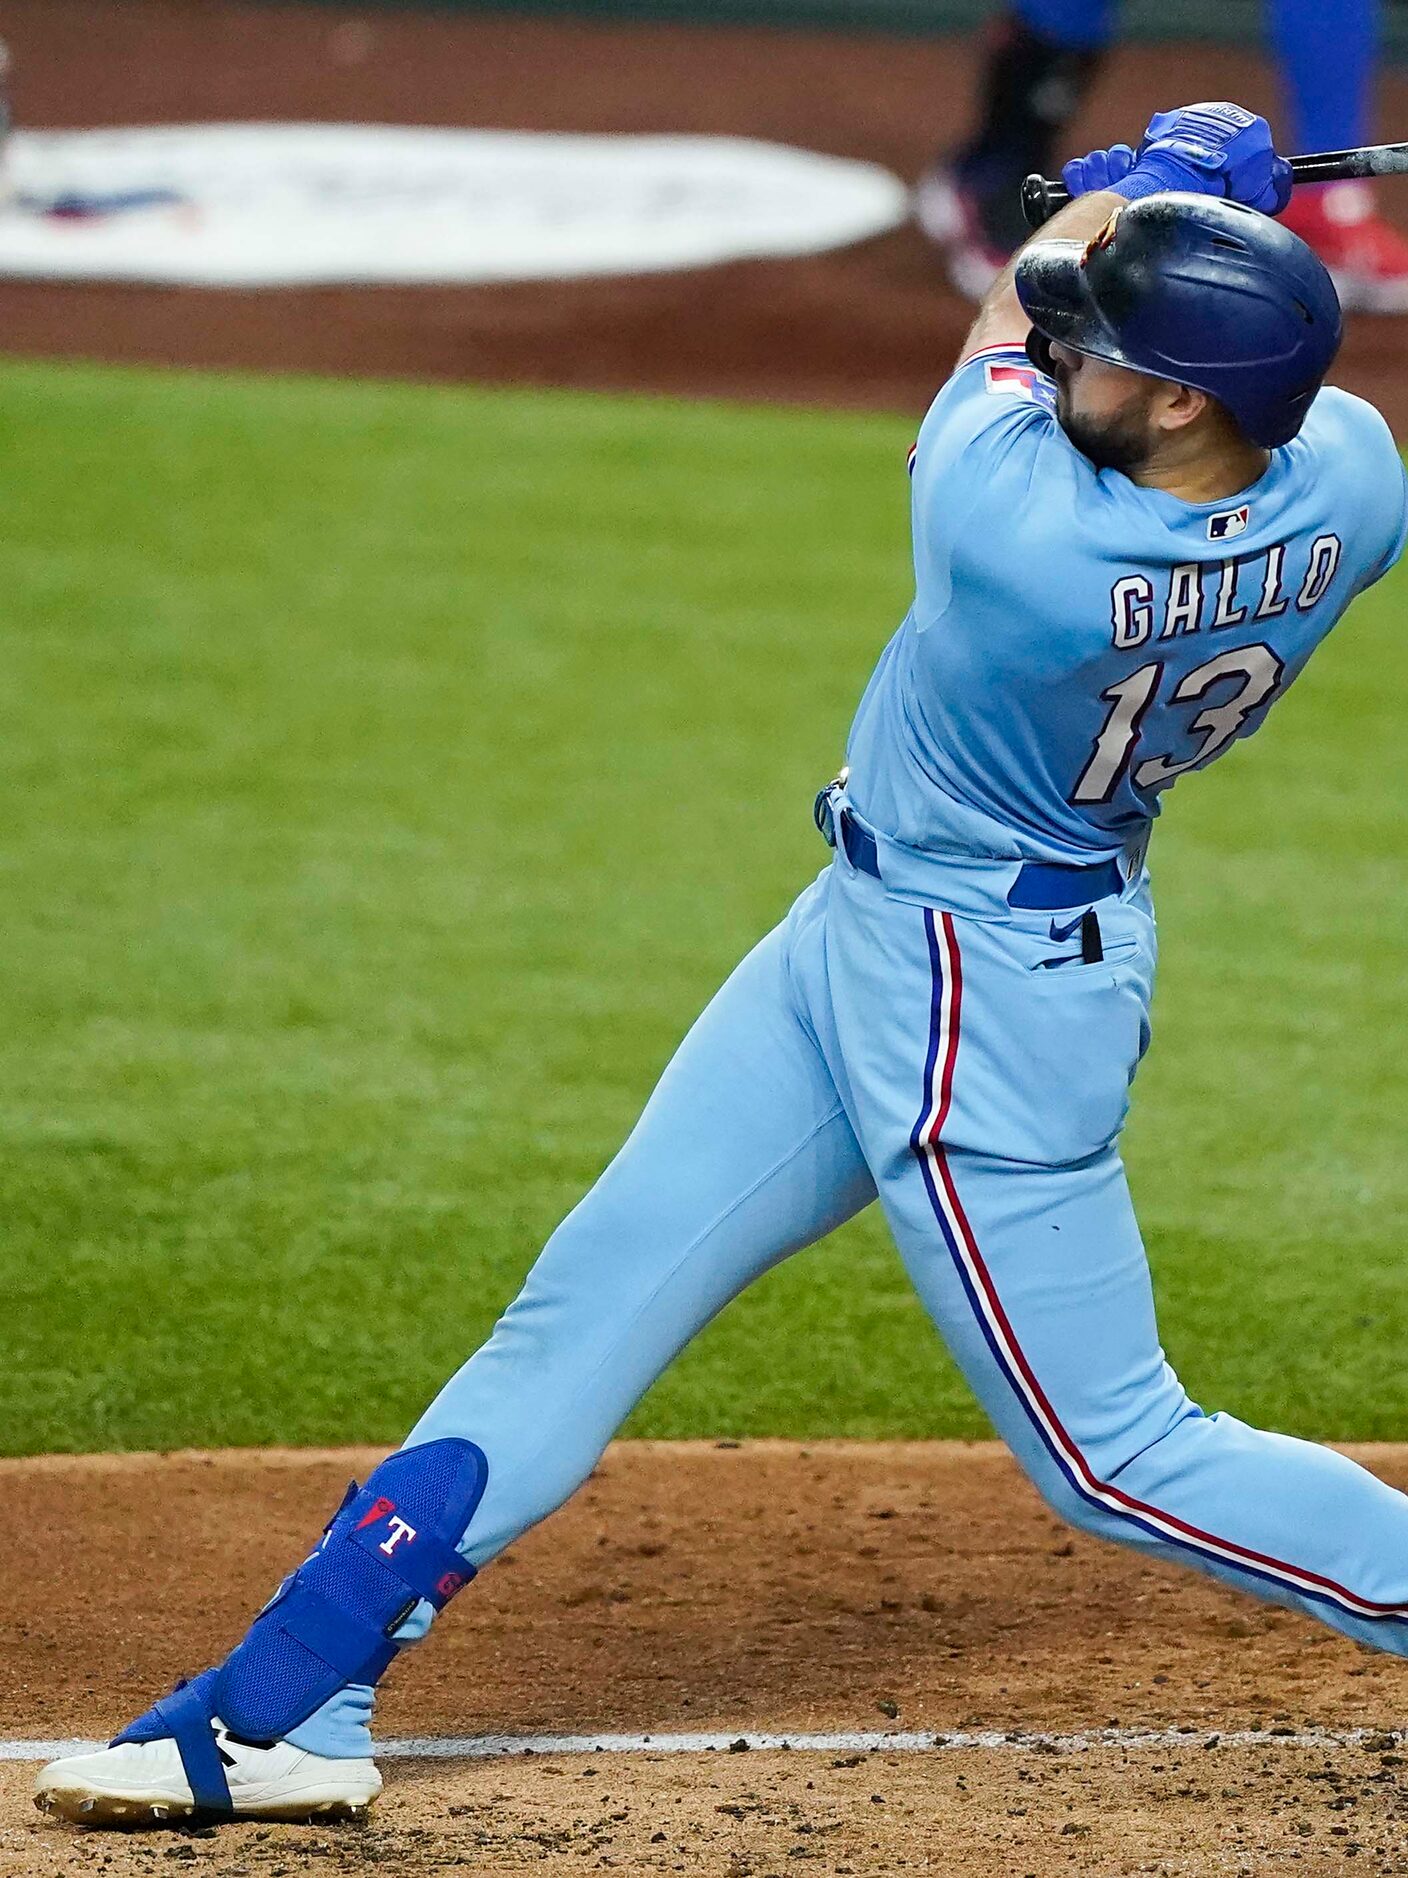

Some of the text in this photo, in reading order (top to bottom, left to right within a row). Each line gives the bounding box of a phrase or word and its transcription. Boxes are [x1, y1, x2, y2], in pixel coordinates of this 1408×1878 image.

[1111, 532, 1342, 651] GALLO
[1069, 641, 1285, 805] 13
[379, 1515, 417, 1556] T
